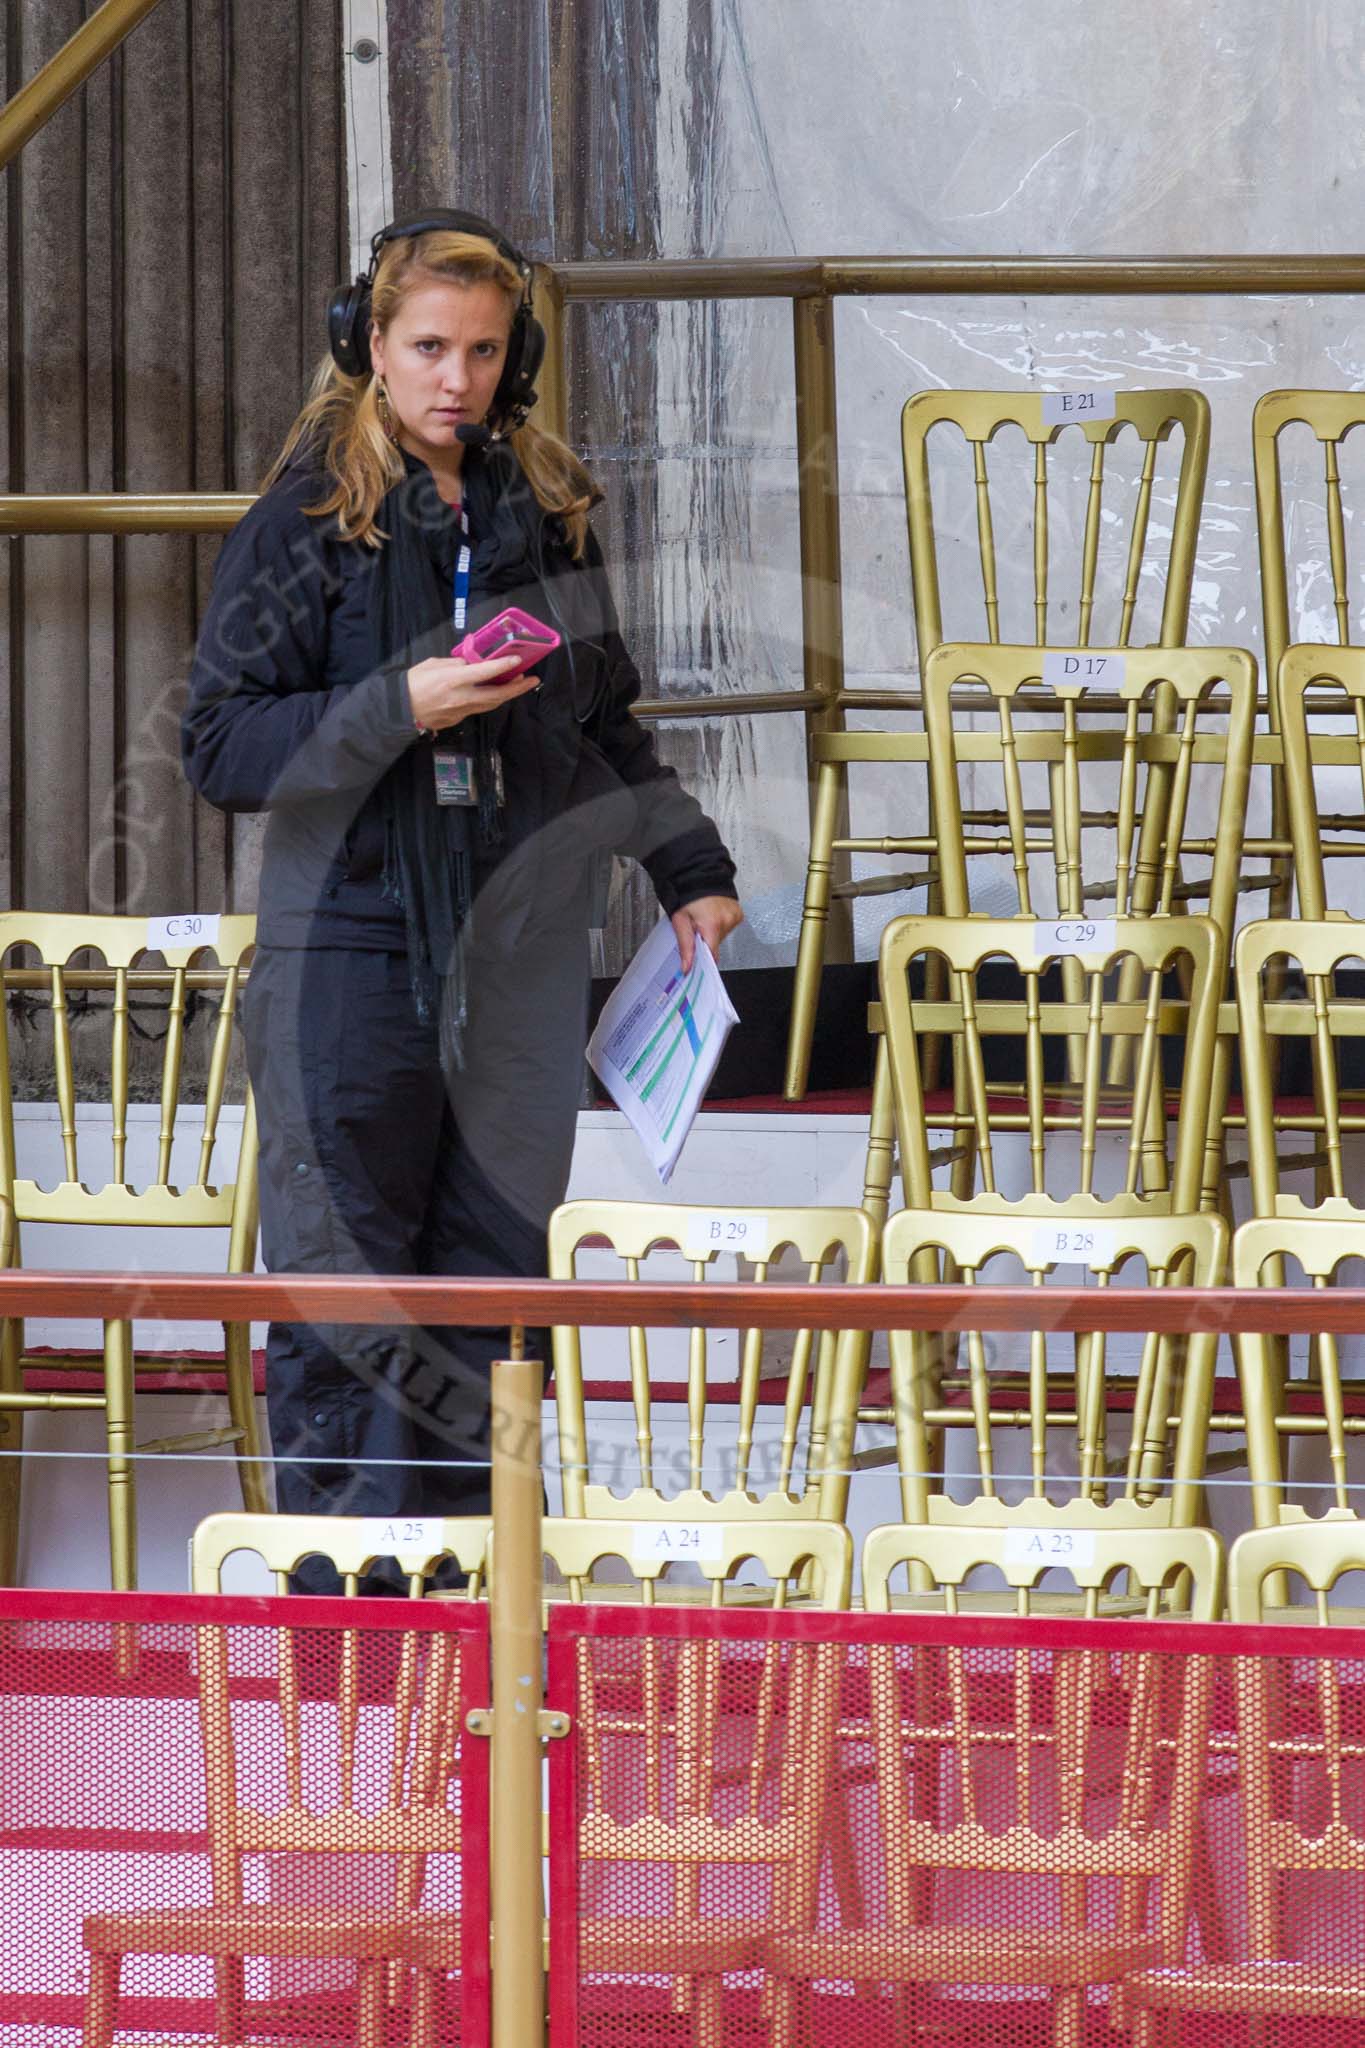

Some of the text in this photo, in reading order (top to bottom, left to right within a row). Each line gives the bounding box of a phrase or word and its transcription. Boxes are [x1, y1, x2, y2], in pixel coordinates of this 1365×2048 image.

[1061, 393, 1096, 411] E 21
[1063, 657, 1106, 675] D 17
[166, 918, 202, 937] C 30
[1054, 925, 1096, 942] C 29
[709, 1221, 747, 1240] B 29
[1055, 1233, 1094, 1251] B 28
[380, 1523, 424, 1541] A 25
[655, 1529, 701, 1547] A 24
[1027, 1535, 1073, 1553] A 23
